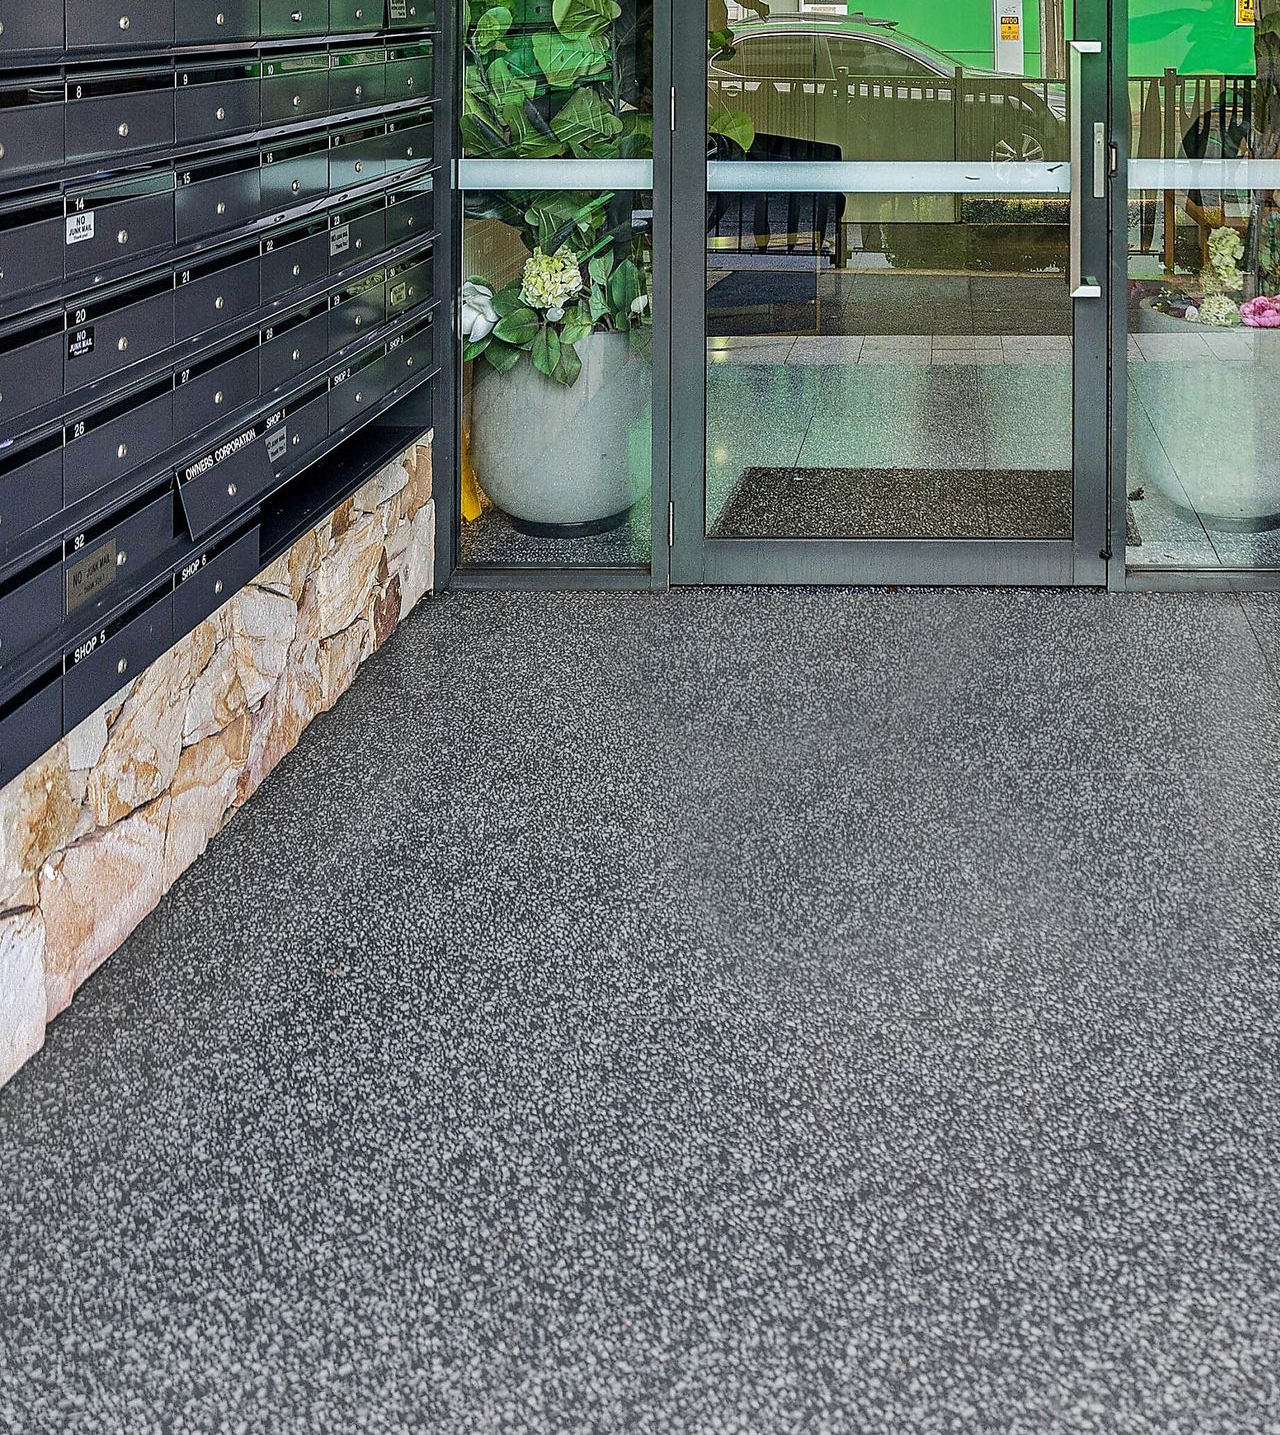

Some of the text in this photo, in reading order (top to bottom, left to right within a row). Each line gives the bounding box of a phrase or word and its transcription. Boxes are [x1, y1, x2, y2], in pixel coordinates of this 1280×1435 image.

[267, 64, 274, 76] 10
[183, 74, 188, 86] 9
[76, 85, 82, 99] 8
[182, 172, 191, 185] 15
[75, 196, 85, 211] 14
[76, 215, 86, 226] NO
[334, 216, 340, 226] 23
[266, 240, 274, 251] 22
[182, 270, 190, 284] 21
[75, 308, 87, 324] 20
[76, 330, 87, 342] NO
[389, 338, 400, 350] SHOP
[181, 369, 190, 384] 27
[333, 371, 346, 385] SHOP
[266, 412, 281, 429] SHOP
[74, 421, 85, 438] 26
[185, 428, 257, 481] OWNERS CORPORATION
[74, 533, 85, 550] 32
[181, 553, 207, 581] SHOP 6
[72, 570, 83, 587] NO
[74, 629, 106, 663] SHOP 5
